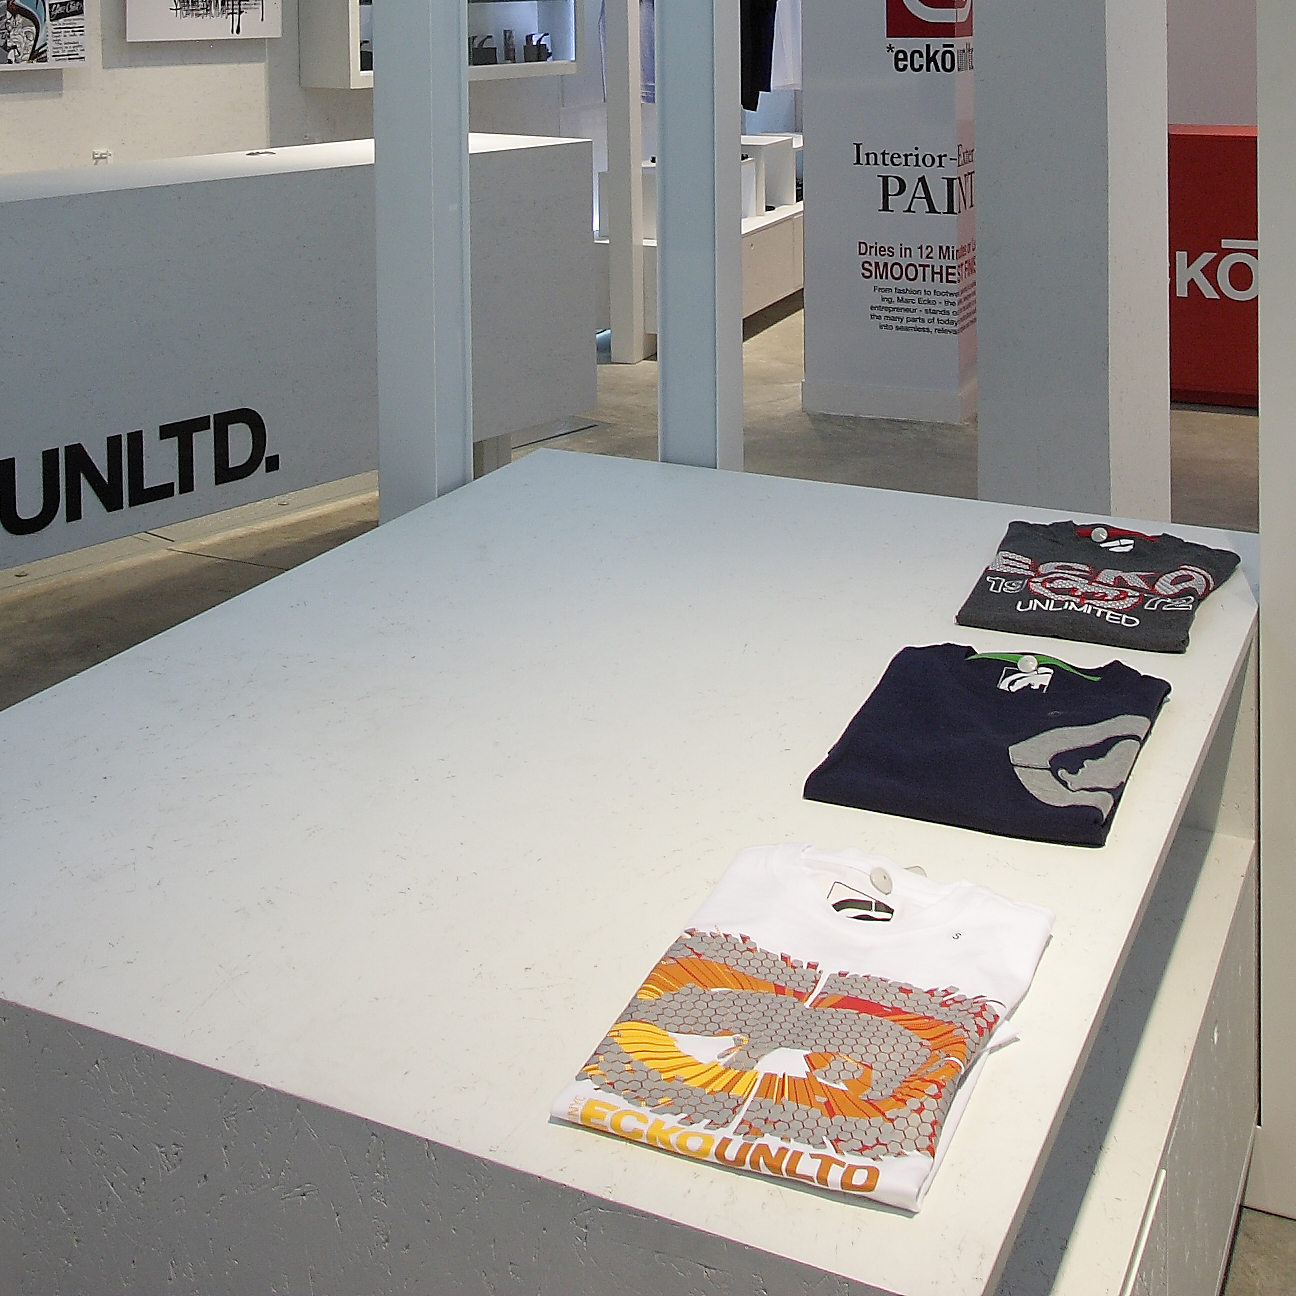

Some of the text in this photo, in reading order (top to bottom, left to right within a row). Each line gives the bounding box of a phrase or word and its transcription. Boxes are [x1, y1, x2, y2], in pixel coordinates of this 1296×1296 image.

[877, 170, 975, 215] PAINT
[858, 241, 894, 257] Dries
[899, 243, 913, 259] in
[917, 245, 934, 260] 12
[1169, 238, 1258, 302] KŌ
[873, 285, 892, 294] From
[894, 286, 922, 296] fashion
[923, 288, 931, 296] to
[896, 296, 916, 304] Marc
[944, 299, 957, 307] the
[869, 305, 950, 316] entrepreneur stands
[870, 313, 882, 321] the
[883, 315, 904, 324] many
[905, 316, 926, 324] parts
[878, 323, 894, 331] into
[1016, 598, 1140, 627] UNLIMITED
